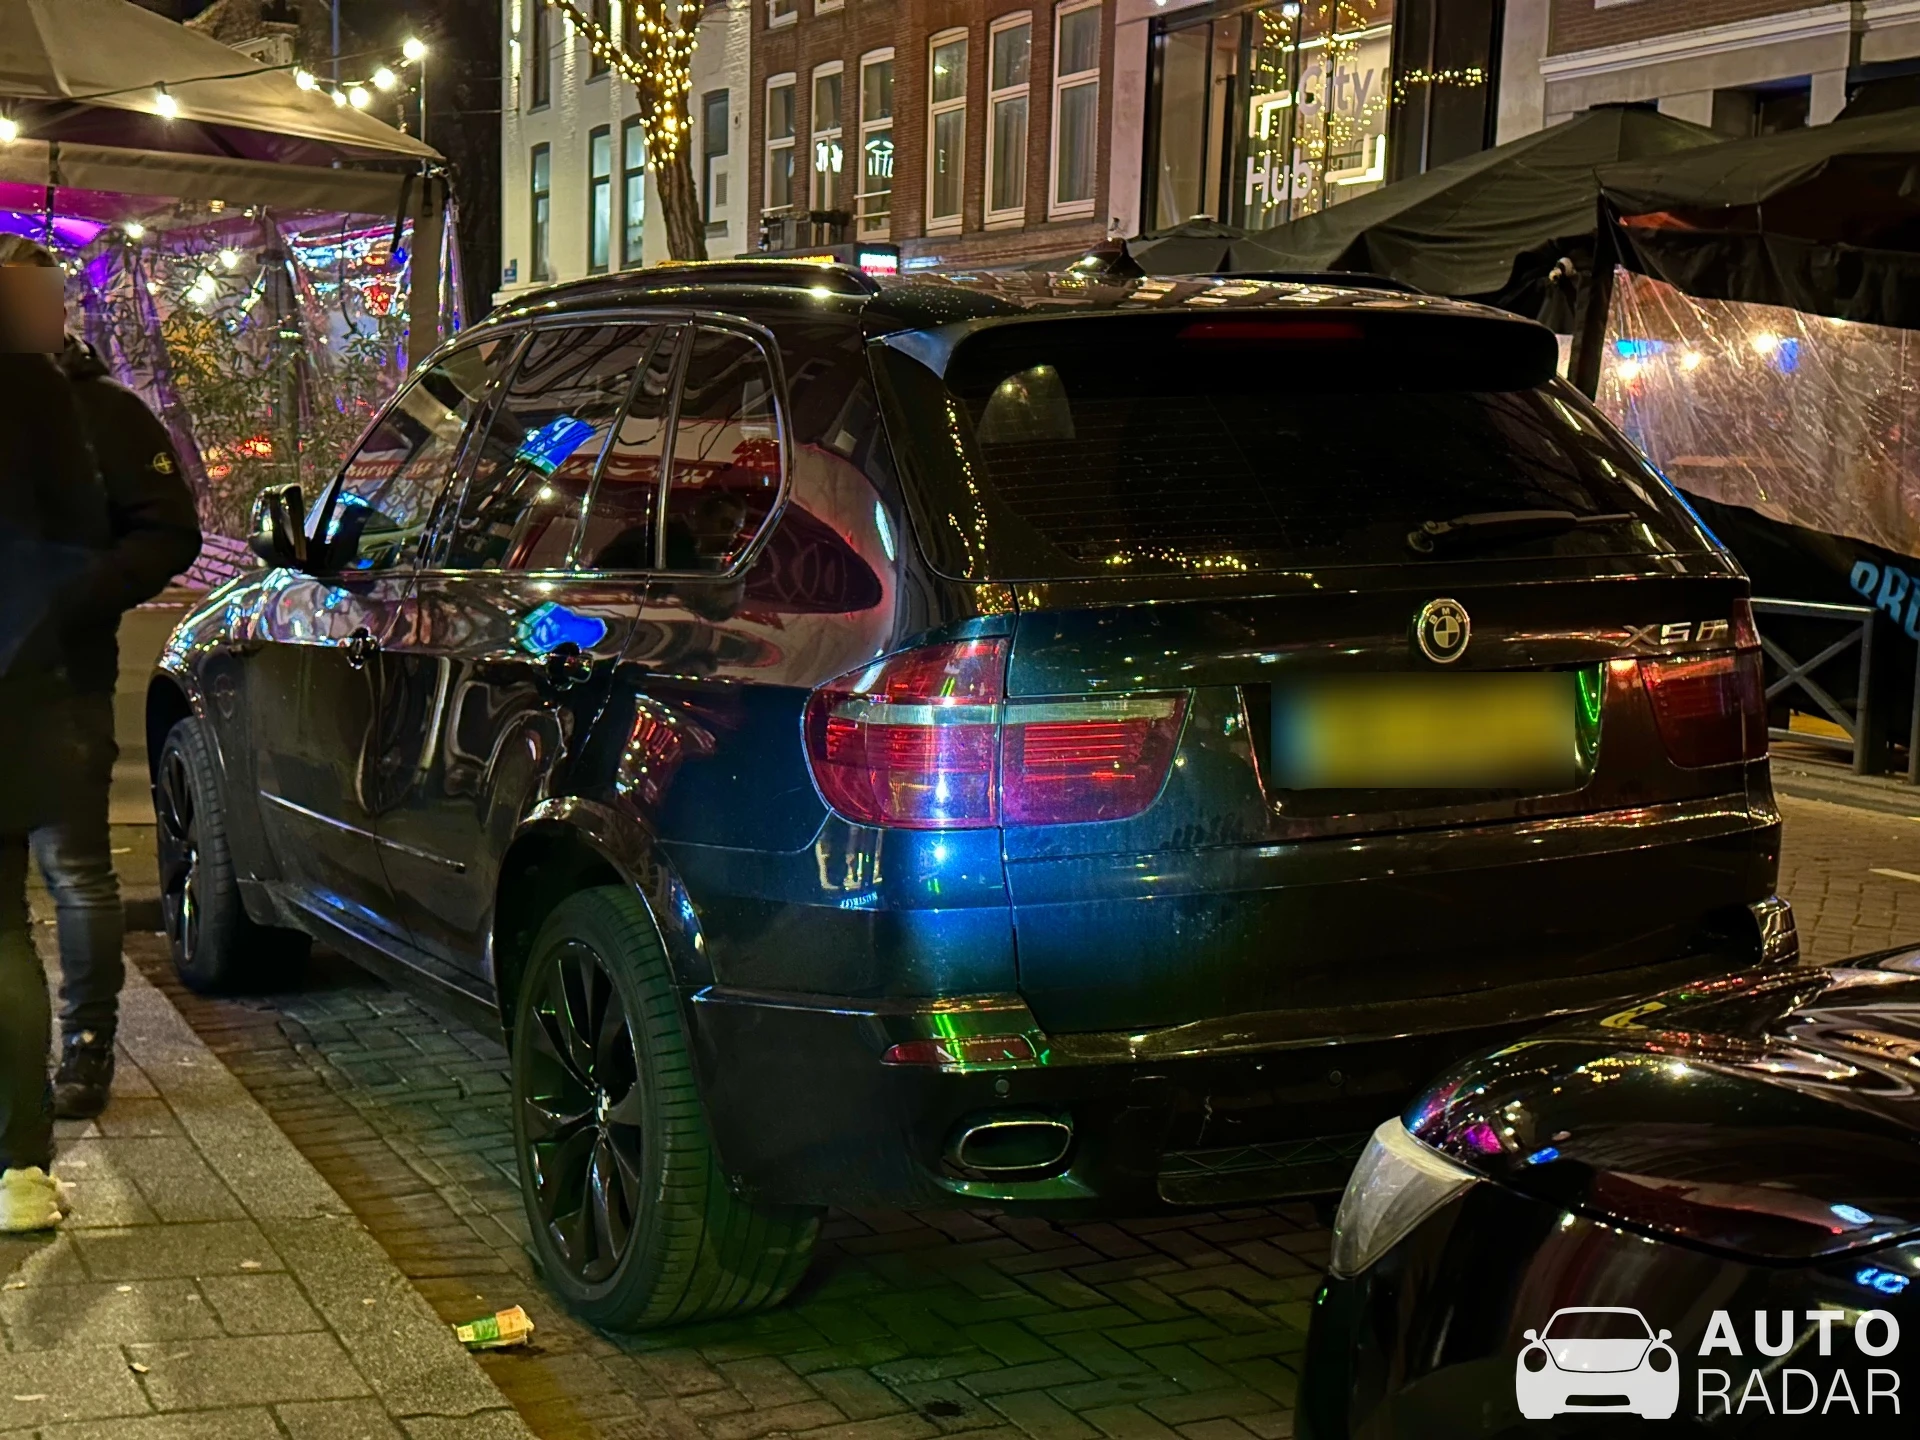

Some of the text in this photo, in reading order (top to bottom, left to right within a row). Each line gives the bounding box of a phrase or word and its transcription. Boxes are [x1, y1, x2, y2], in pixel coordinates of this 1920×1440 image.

[1298, 60, 1374, 124] City
[1245, 148, 1312, 205] Hub
[1429, 607, 1463, 625] BMW
